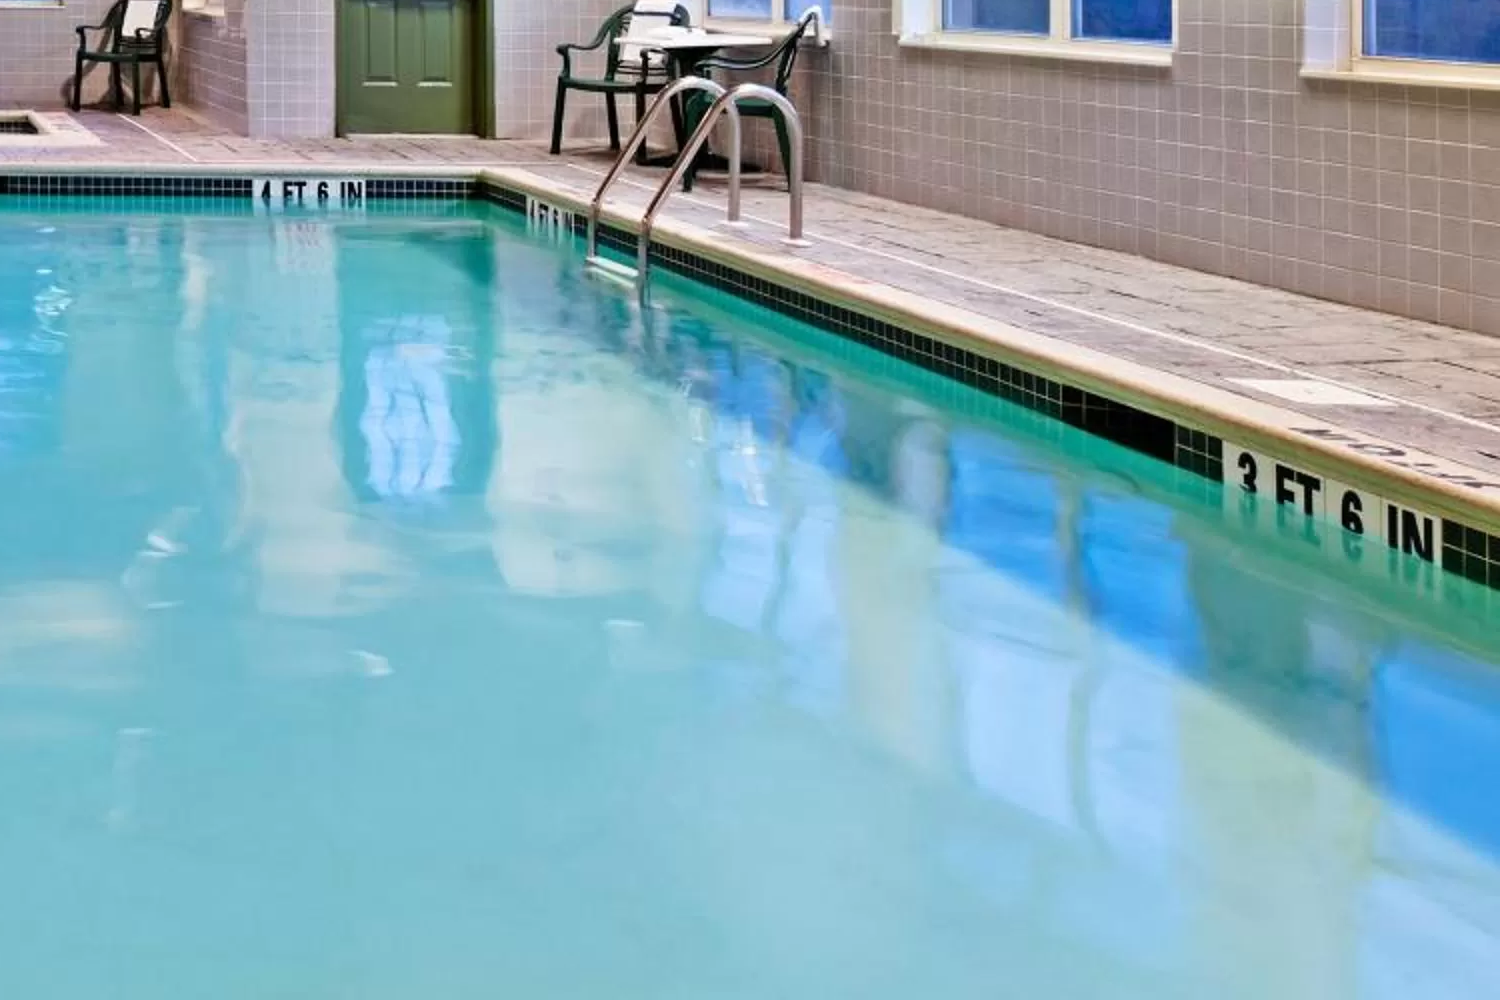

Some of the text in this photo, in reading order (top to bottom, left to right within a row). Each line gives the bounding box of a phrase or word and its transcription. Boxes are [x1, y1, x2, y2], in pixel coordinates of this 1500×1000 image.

[261, 180, 363, 200] 4 FT 6 IN
[1237, 451, 1258, 493] 3
[1275, 463, 1322, 516] FT
[1341, 489, 1364, 535] 6
[1387, 503, 1434, 563] IN
